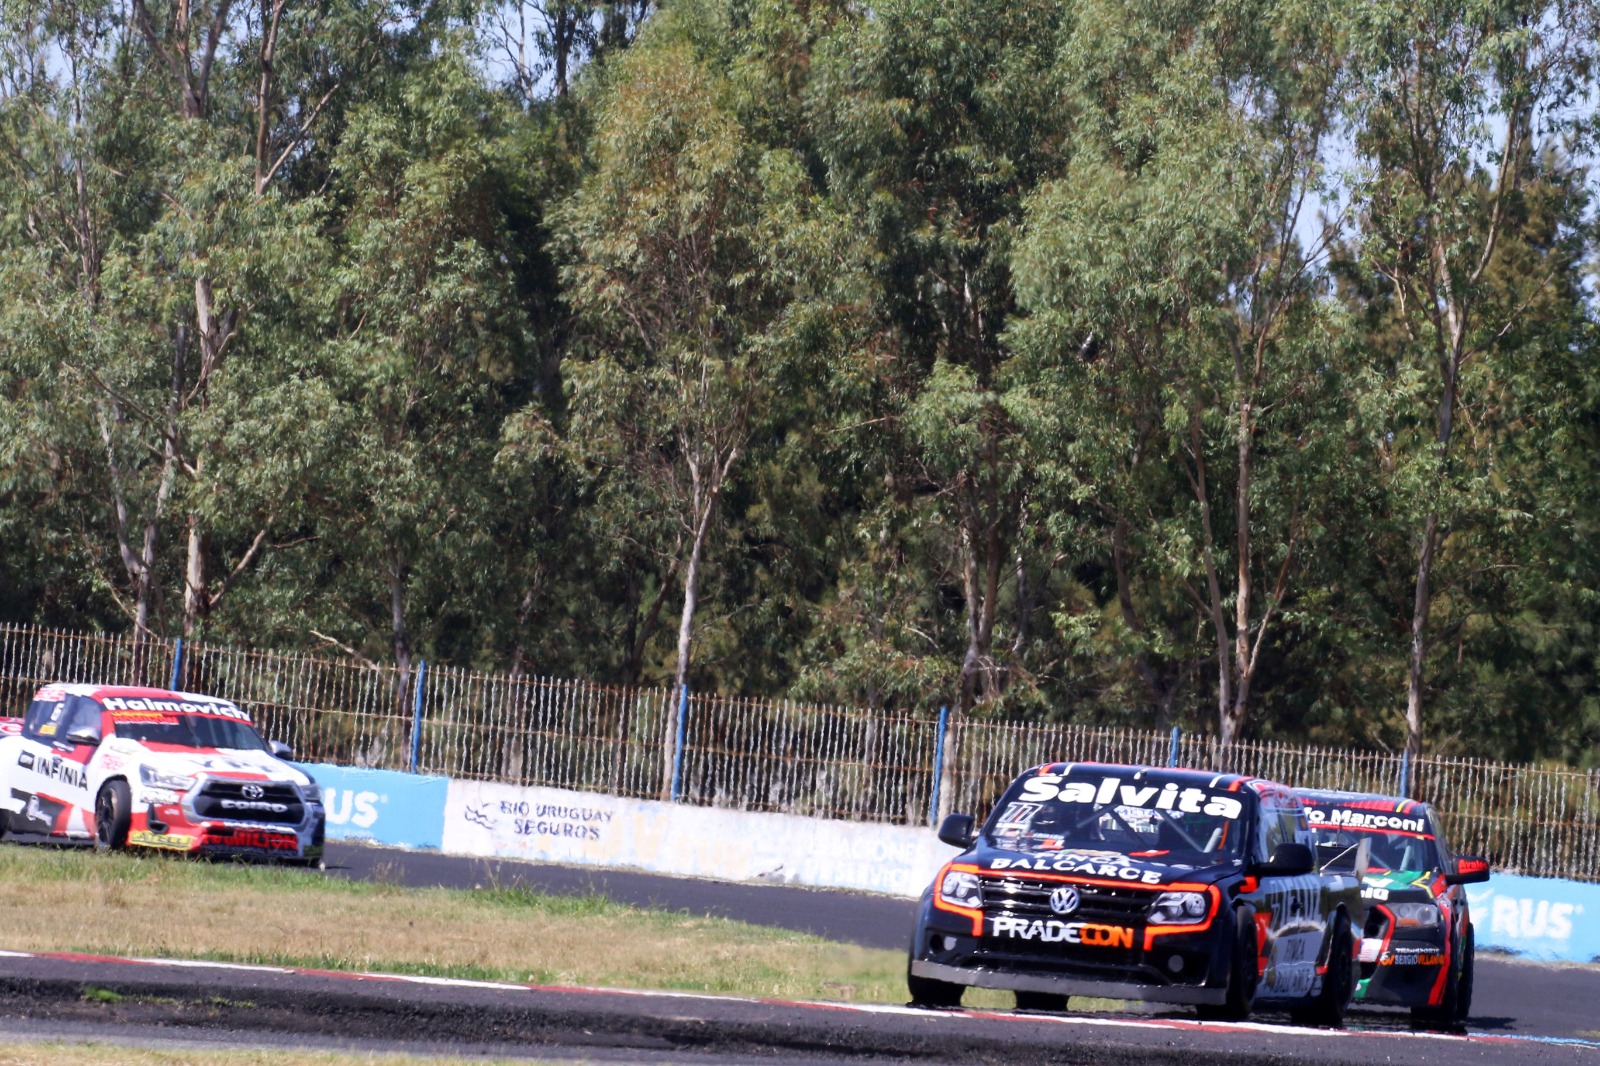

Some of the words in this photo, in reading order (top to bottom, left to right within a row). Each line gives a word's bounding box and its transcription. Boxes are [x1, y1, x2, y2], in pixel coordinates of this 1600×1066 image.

[37, 757, 88, 791] INFINIA
[324, 787, 379, 828] US
[500, 800, 530, 816] RIO
[536, 804, 614, 822] URUGUAY
[1018, 774, 1243, 820] Salvita
[514, 819, 600, 841] SEGUROS
[1330, 809, 1425, 832] Marconi
[990, 858, 1162, 885] BALCARCE
[992, 916, 1134, 948] PRADECON
[1491, 894, 1574, 940] RUS
